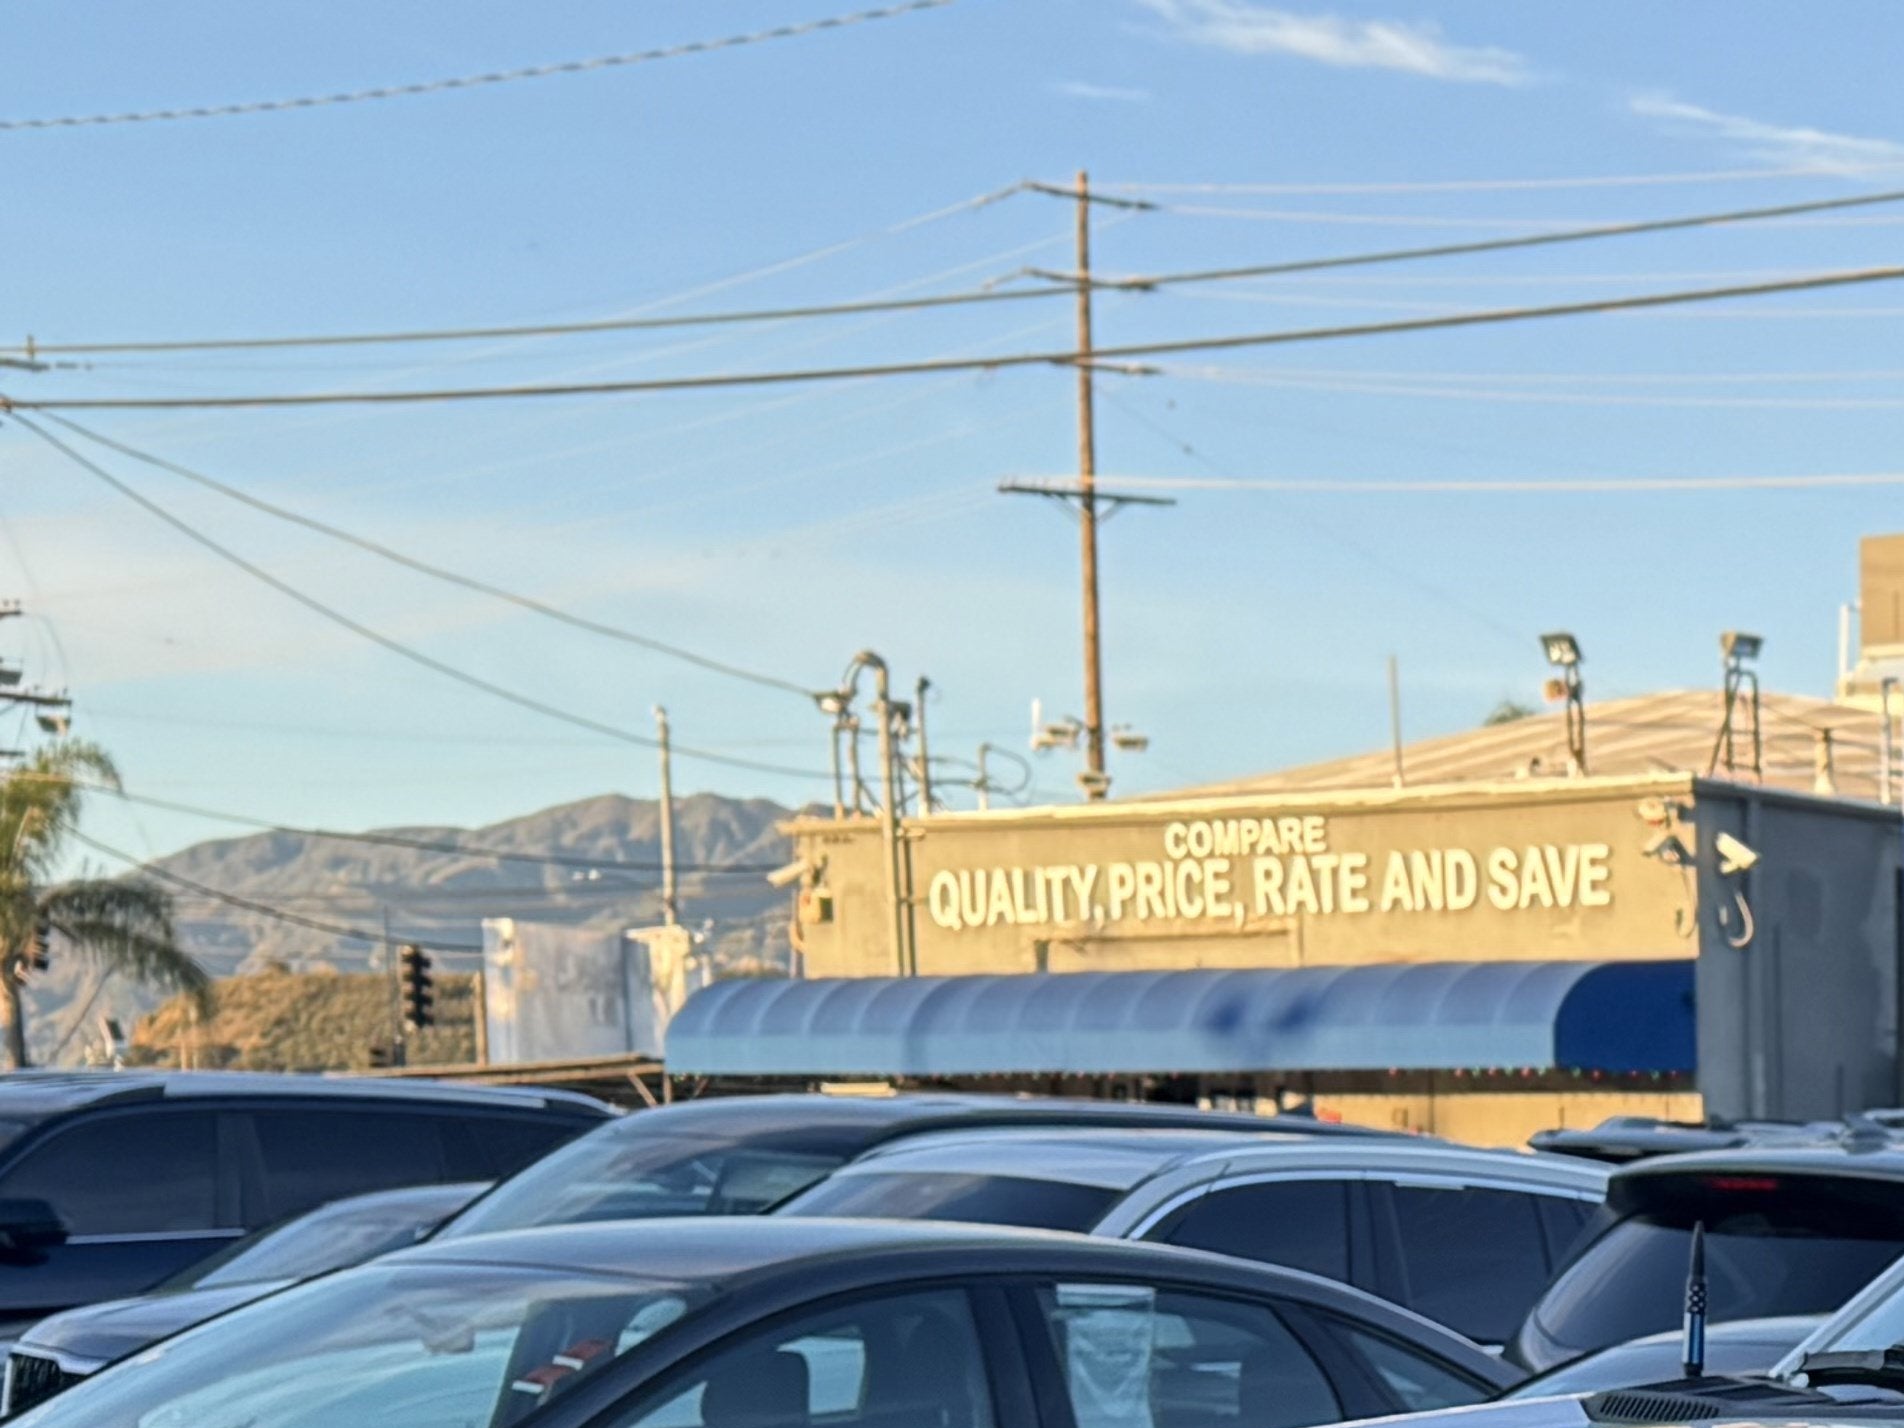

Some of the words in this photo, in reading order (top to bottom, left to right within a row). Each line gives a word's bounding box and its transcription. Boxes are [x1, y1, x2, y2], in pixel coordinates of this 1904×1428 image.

[1164, 816, 1327, 859] COMPARE
[928, 864, 1105, 931] QUALITY,
[1108, 857, 1245, 928] PRICE,
[1253, 852, 1369, 916] RATE
[1380, 848, 1477, 912] AND
[1487, 843, 1612, 910] SAVE
